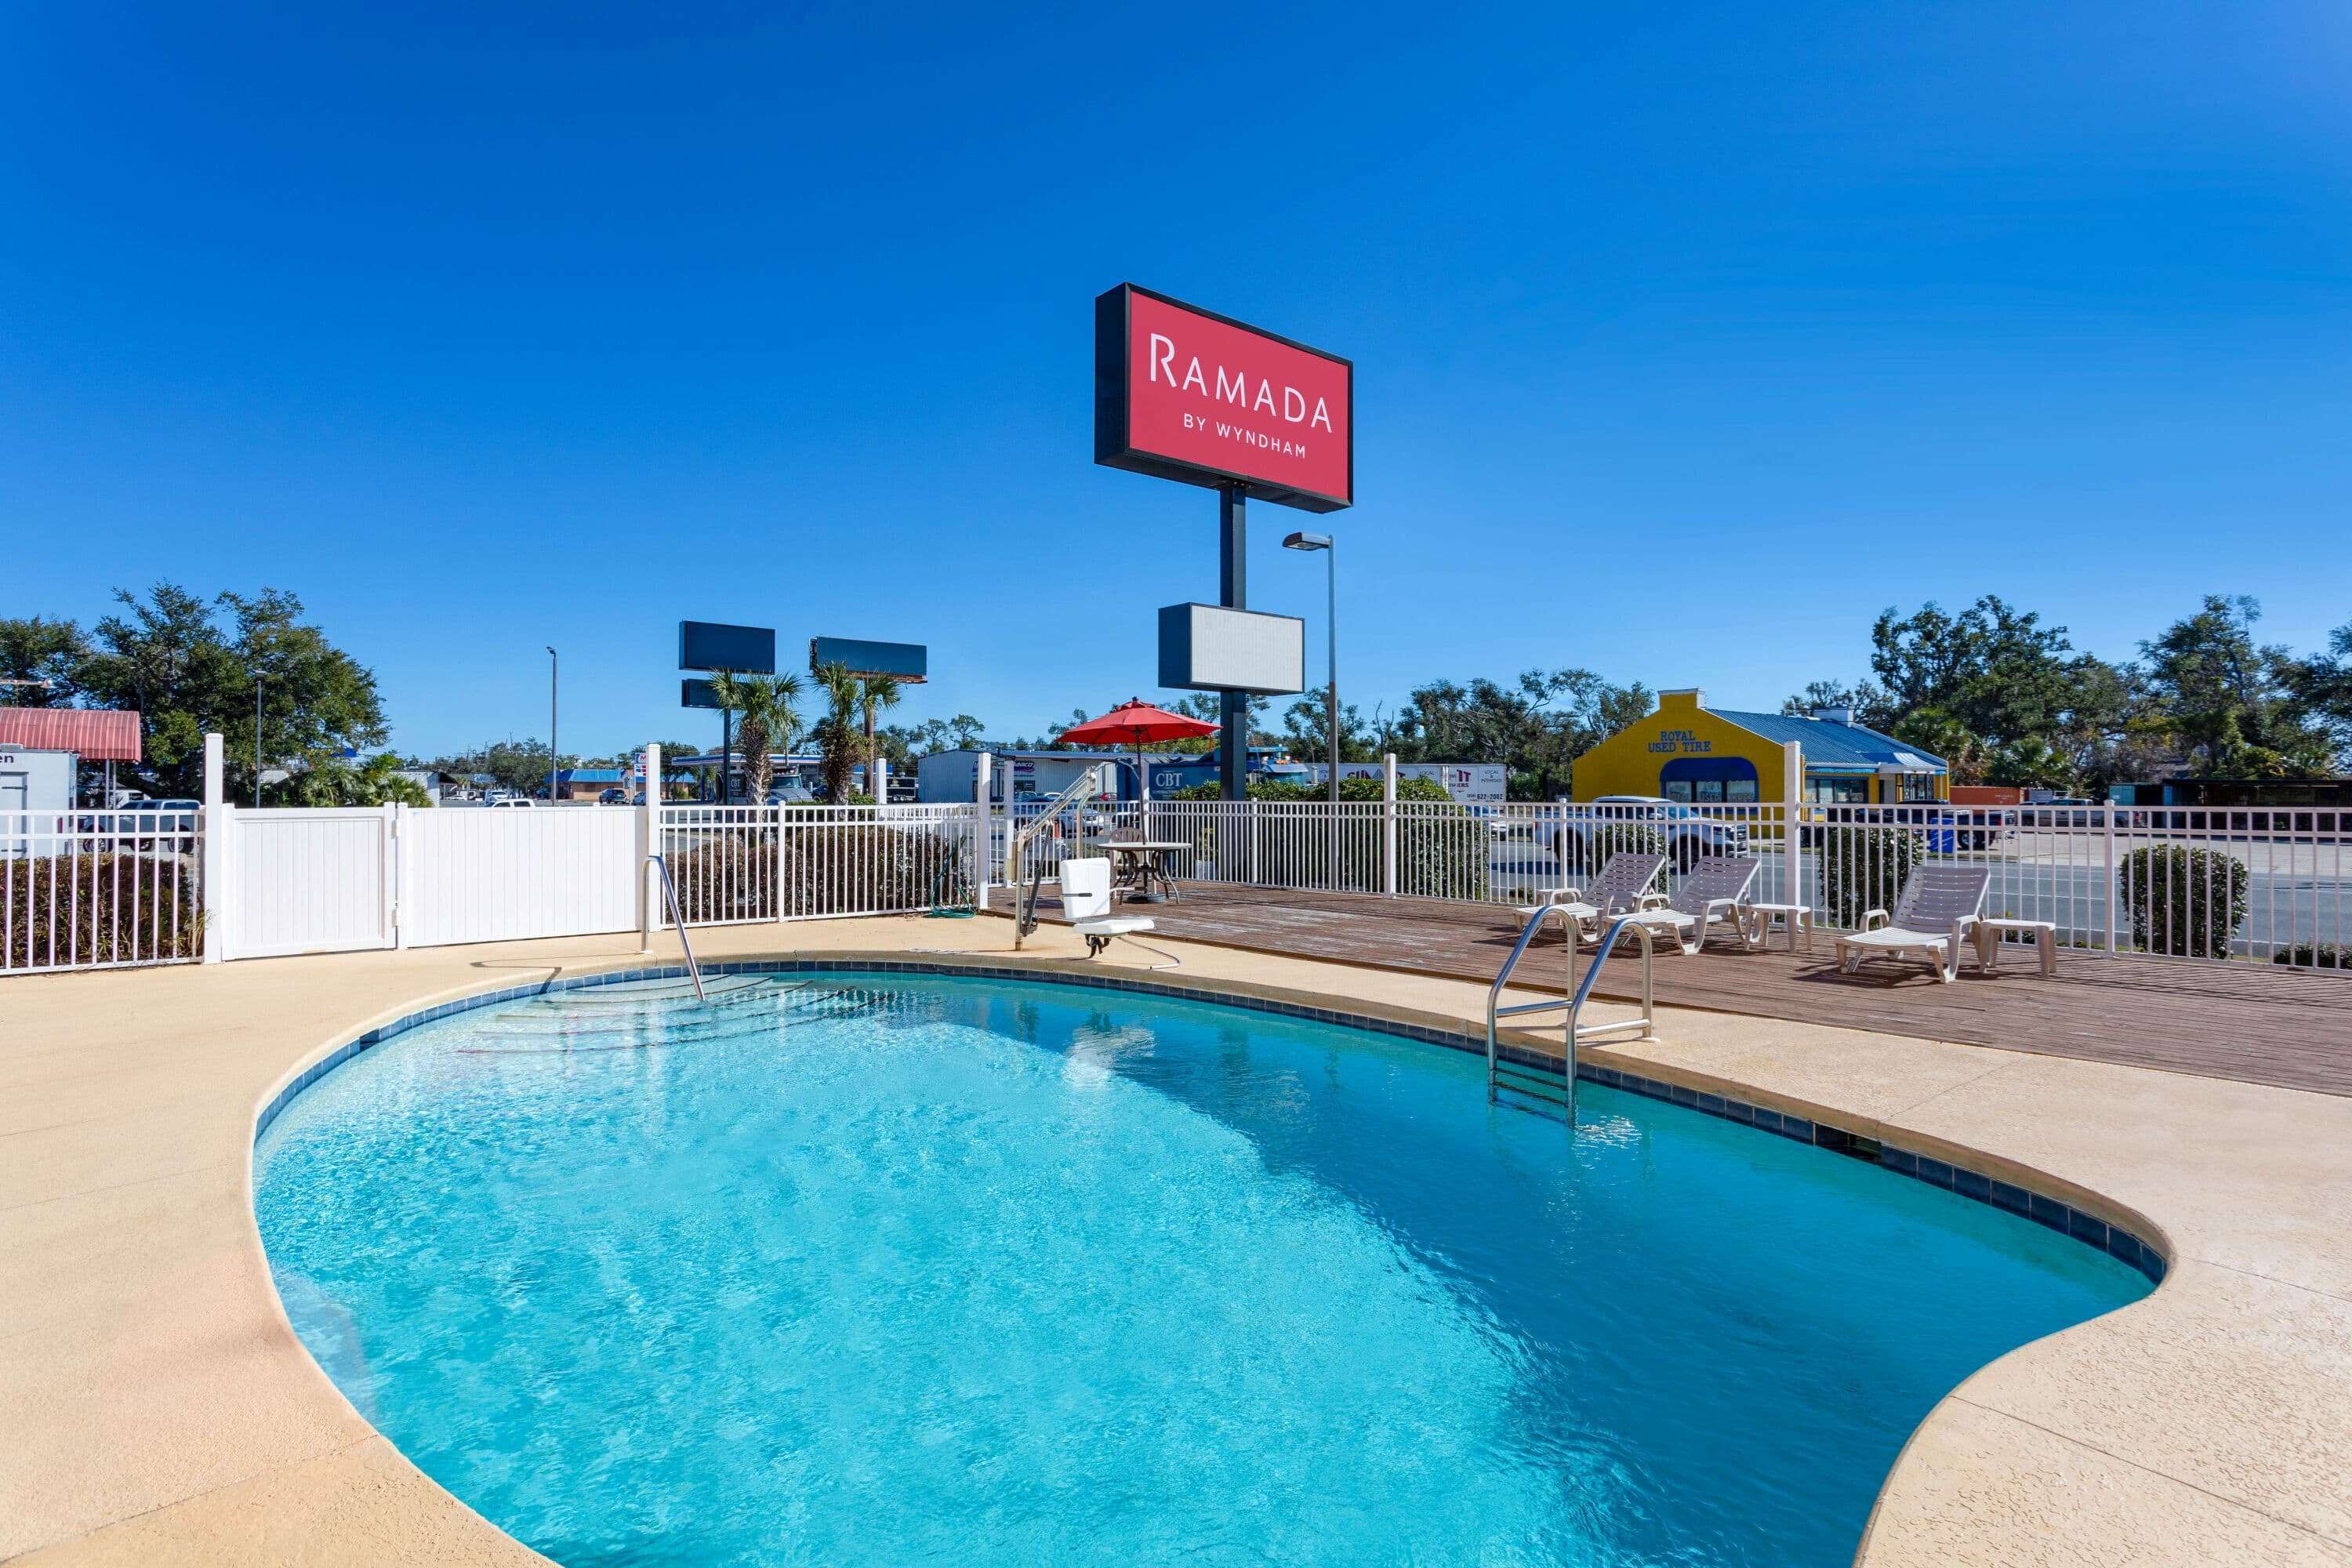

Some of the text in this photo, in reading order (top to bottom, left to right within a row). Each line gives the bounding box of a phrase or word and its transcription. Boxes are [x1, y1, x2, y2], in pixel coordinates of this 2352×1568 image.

[1150, 332, 1332, 433] RAMADA
[1184, 413, 1305, 459] BY WYNDHAM
[1661, 730, 1695, 742] ROYAL
[1648, 741, 1711, 753] USED TIRE
[1156, 773, 1183, 787] CBT
